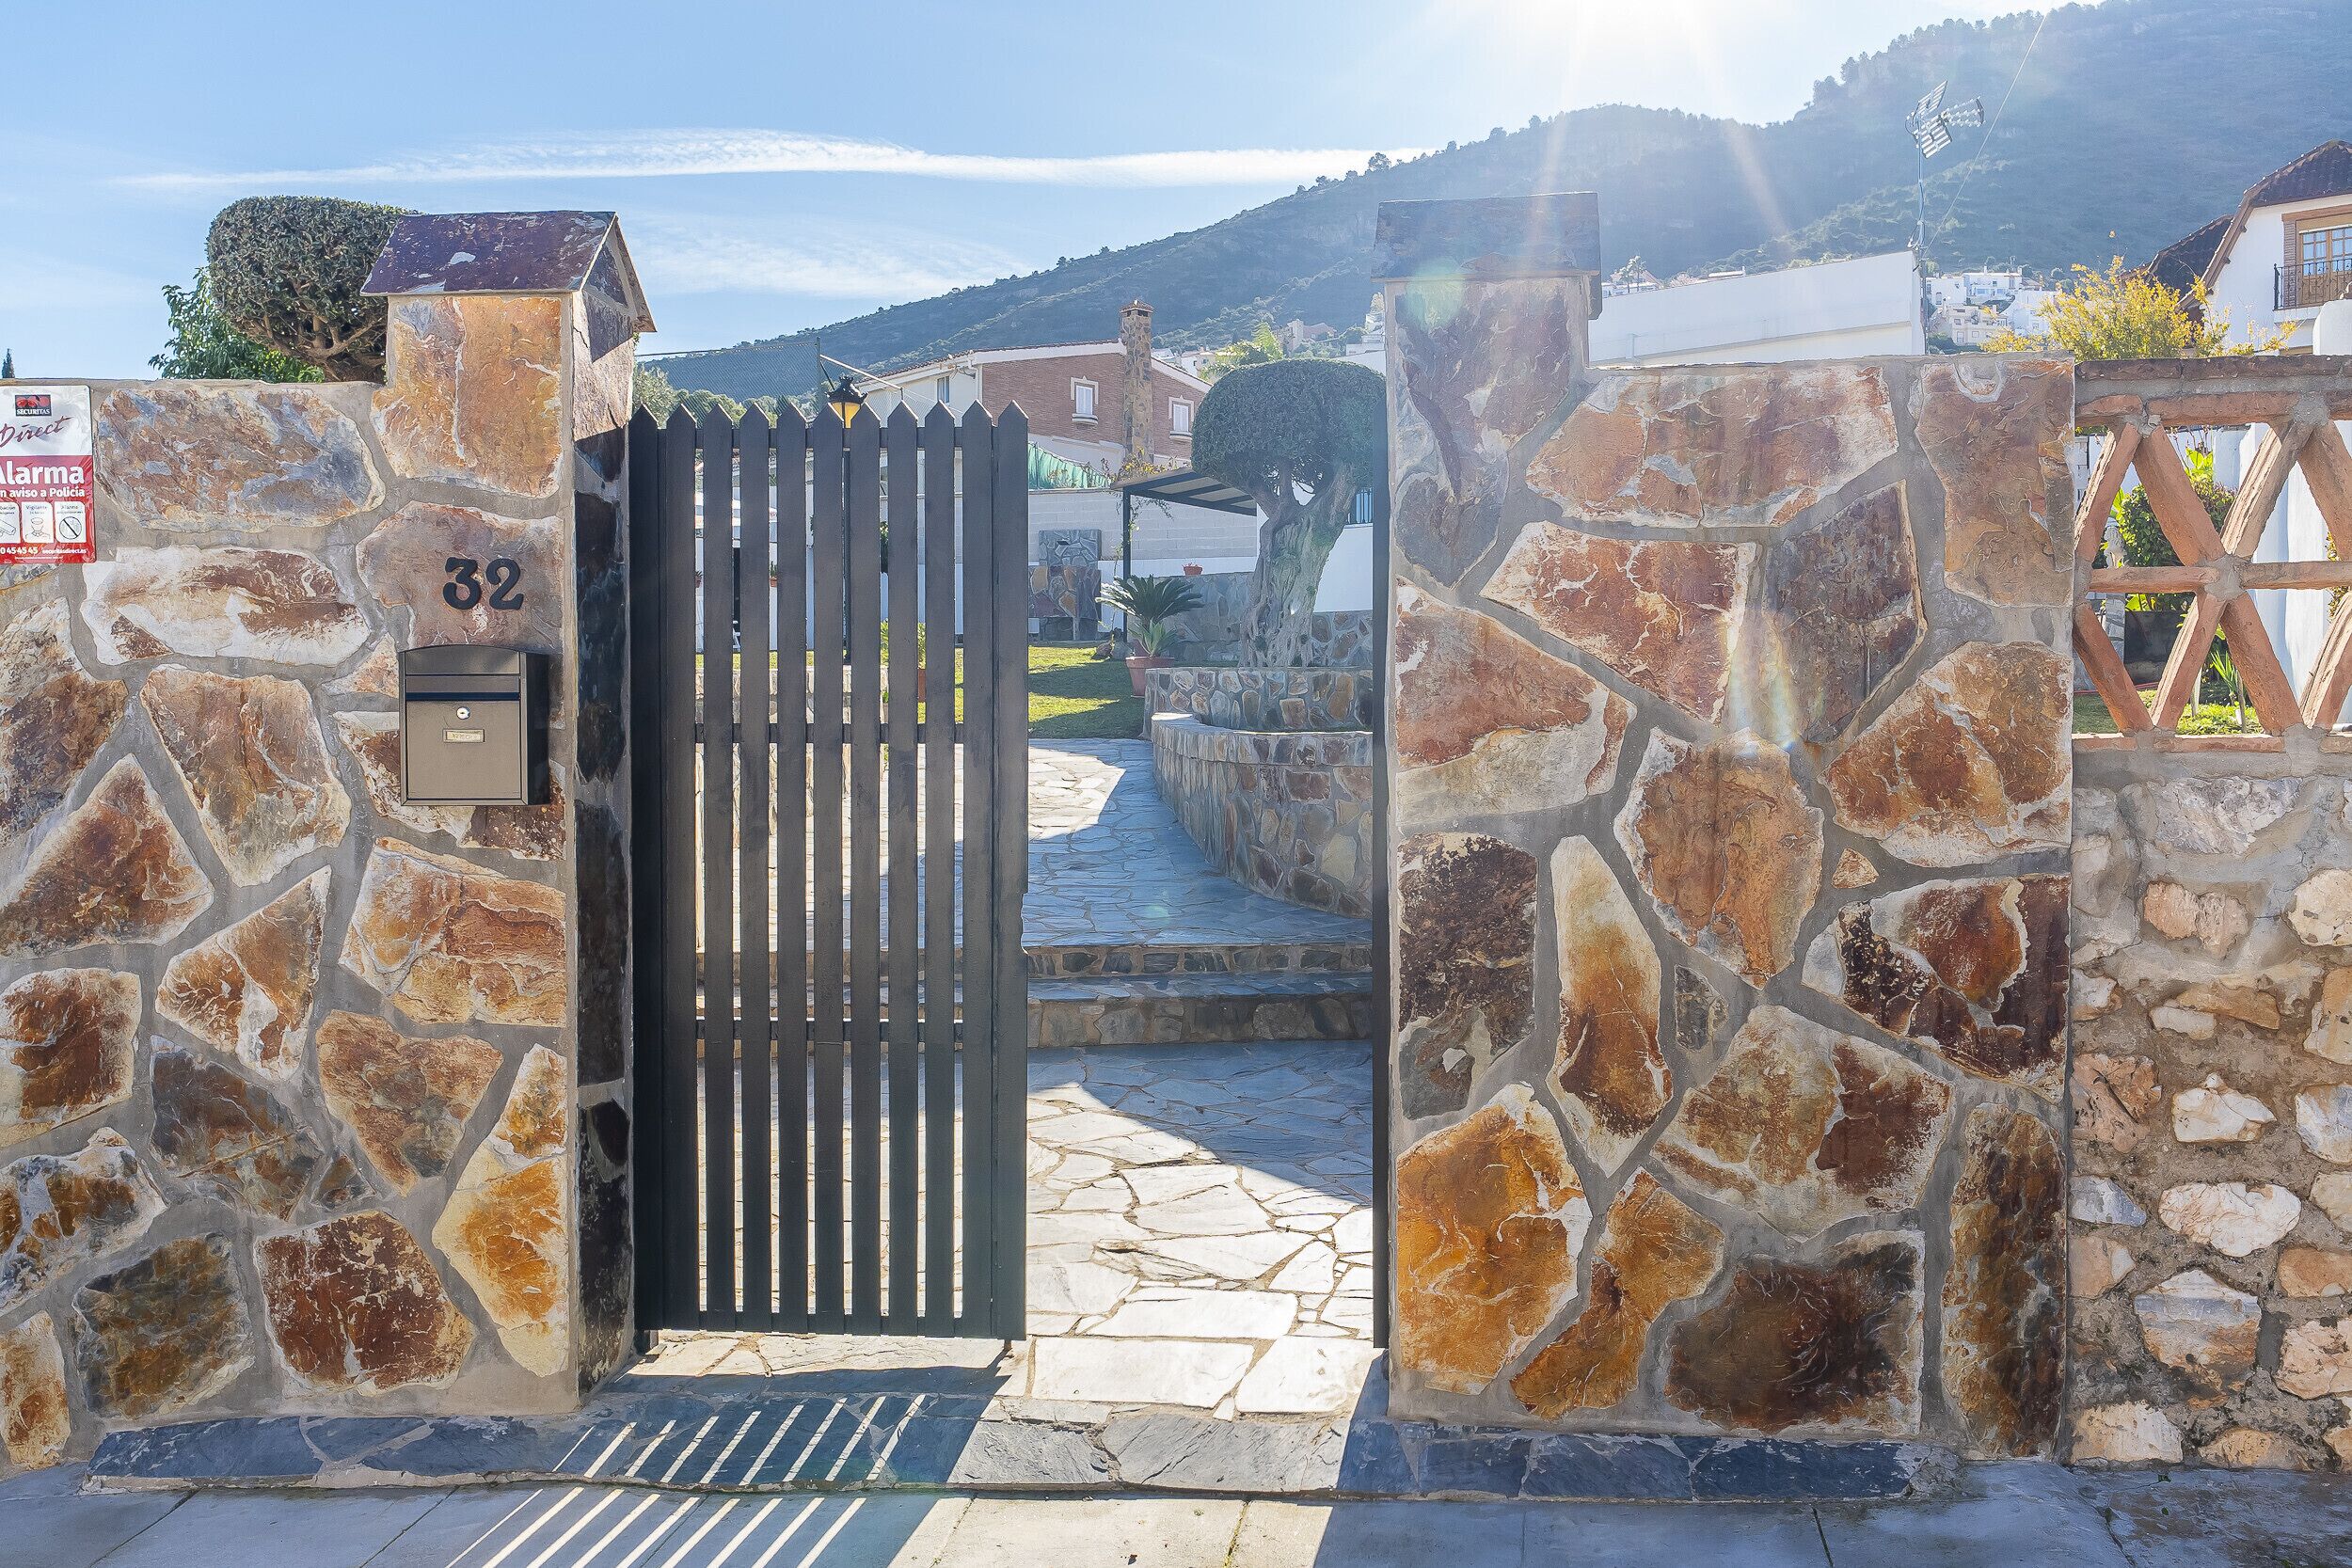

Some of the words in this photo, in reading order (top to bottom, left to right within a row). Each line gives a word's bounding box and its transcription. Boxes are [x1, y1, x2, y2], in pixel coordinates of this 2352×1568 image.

[0, 416, 74, 448] Direct
[9, 486, 39, 498] aviso
[40, 488, 47, 498] a
[49, 485, 86, 498] Policía
[7, 546, 17, 555] 45
[17, 546, 27, 555] 45
[28, 546, 39, 555] 45
[443, 557, 524, 610] 32
